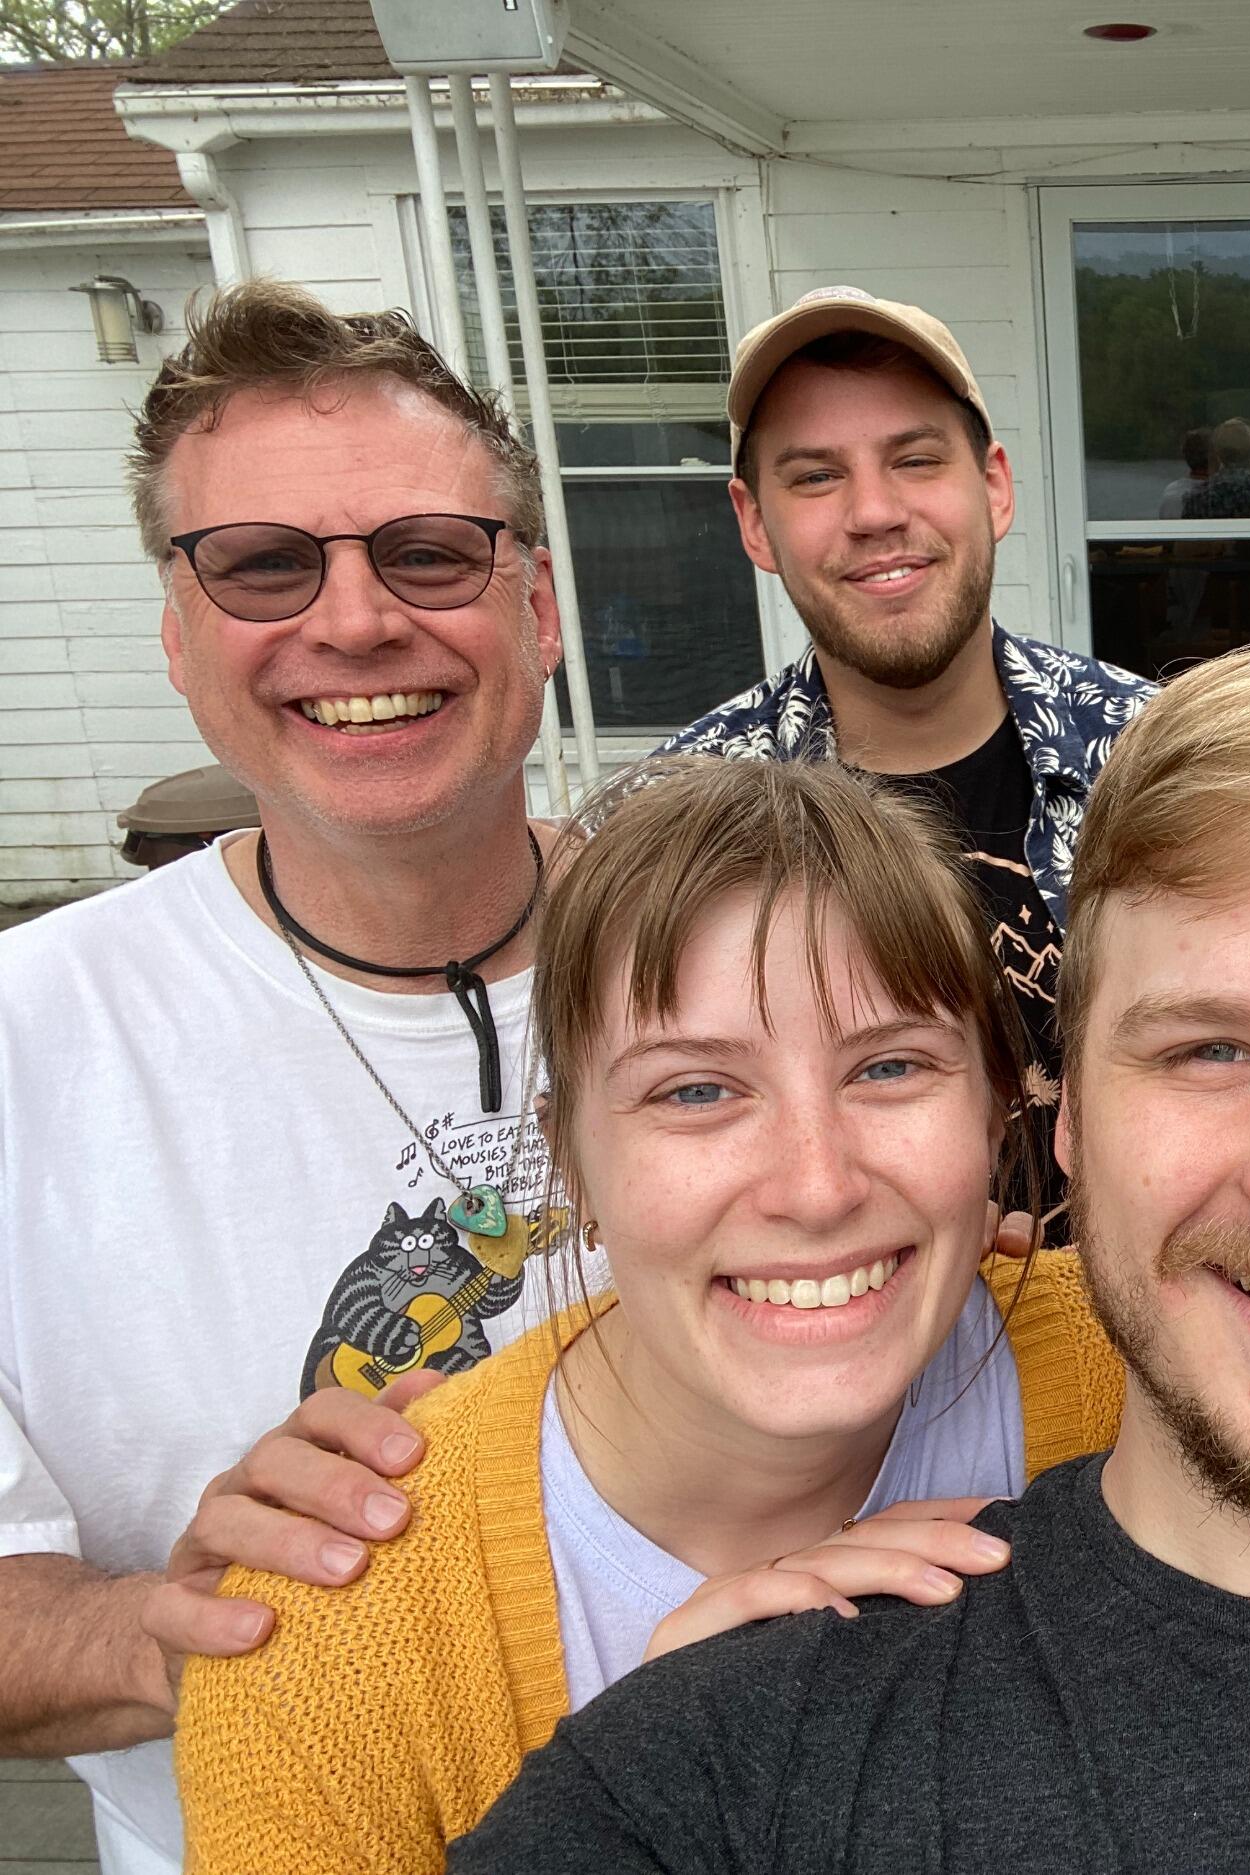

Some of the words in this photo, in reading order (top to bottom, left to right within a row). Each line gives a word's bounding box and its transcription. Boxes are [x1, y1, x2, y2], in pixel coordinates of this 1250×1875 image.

[440, 1134, 475, 1156] LOVE
[478, 1131, 493, 1147] TO
[497, 1124, 521, 1143] EAT
[525, 1122, 540, 1136] TH
[450, 1145, 507, 1170] MOUSIES
[485, 1161, 515, 1181] BITE
